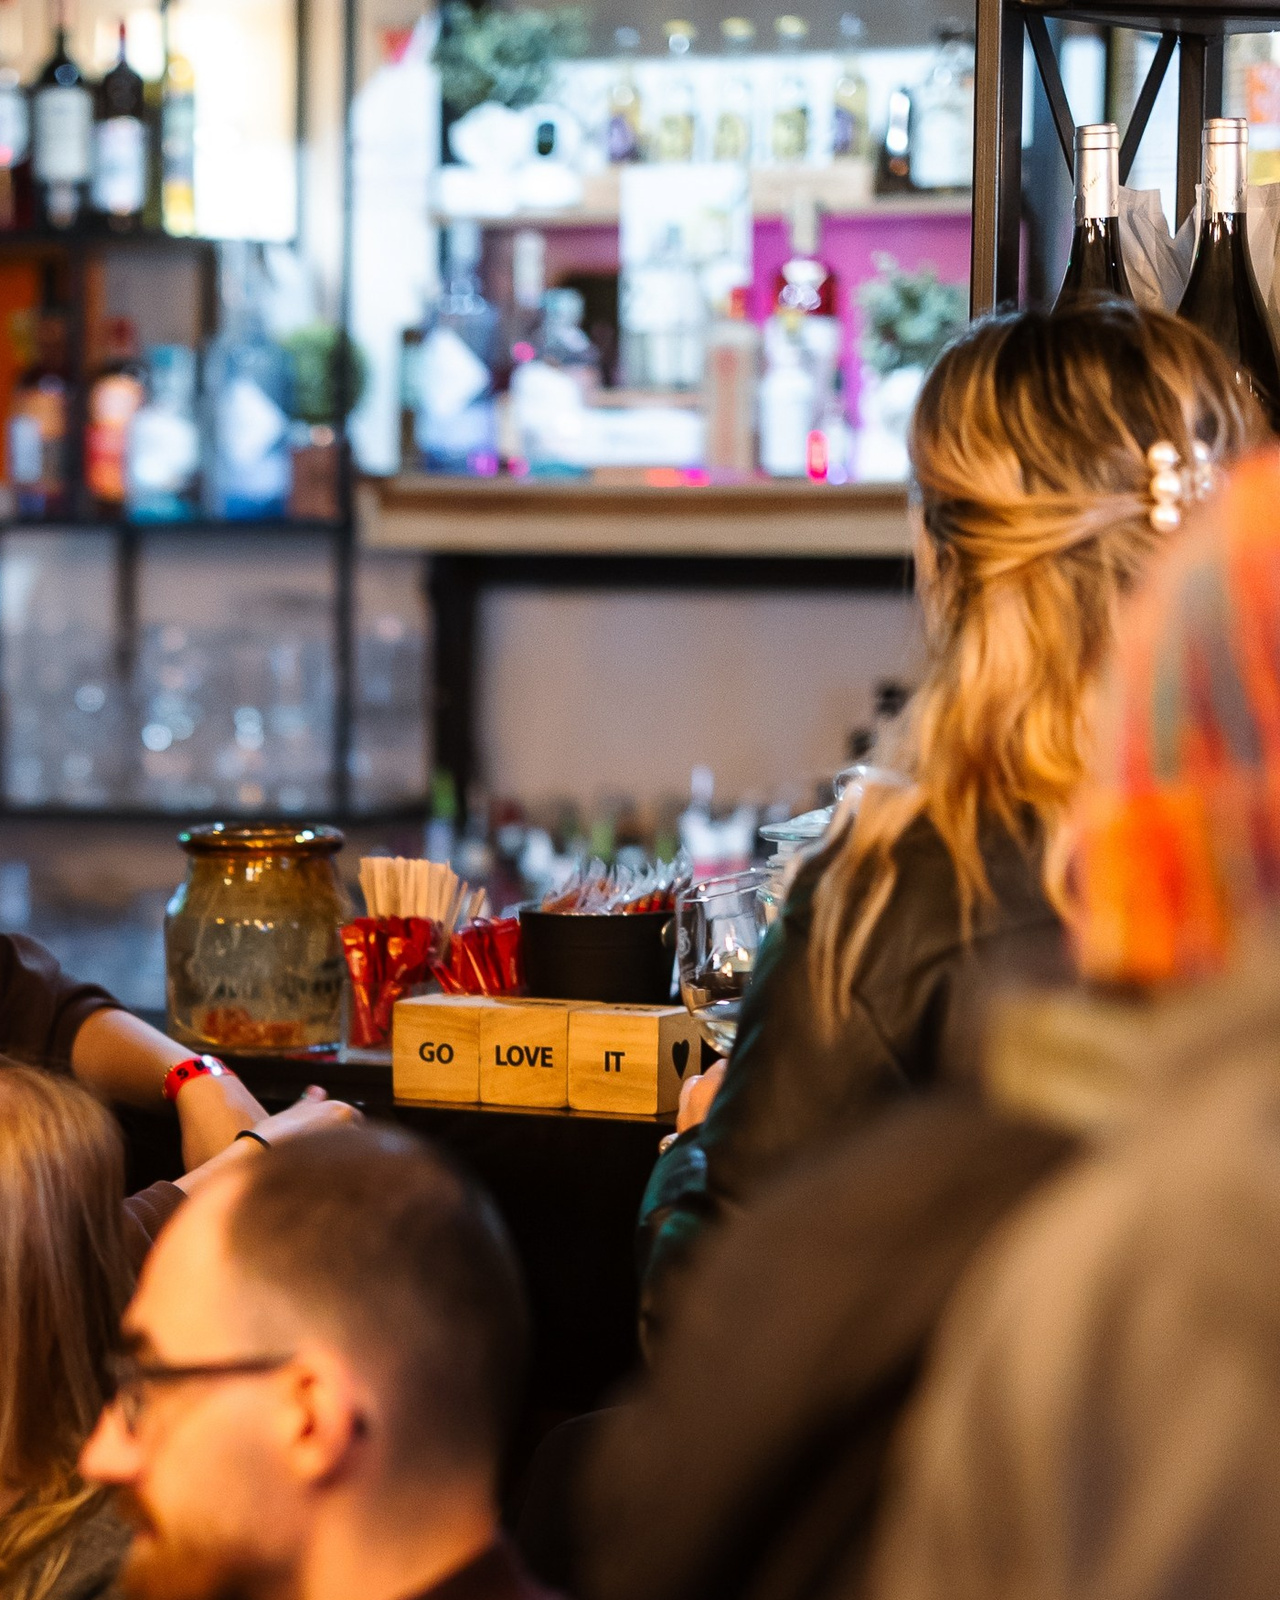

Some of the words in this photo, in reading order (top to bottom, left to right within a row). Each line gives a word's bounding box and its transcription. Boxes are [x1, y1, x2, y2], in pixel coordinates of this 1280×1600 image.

[419, 1042, 454, 1064] GO
[495, 1045, 554, 1068] LOVE
[604, 1051, 625, 1073] IT
